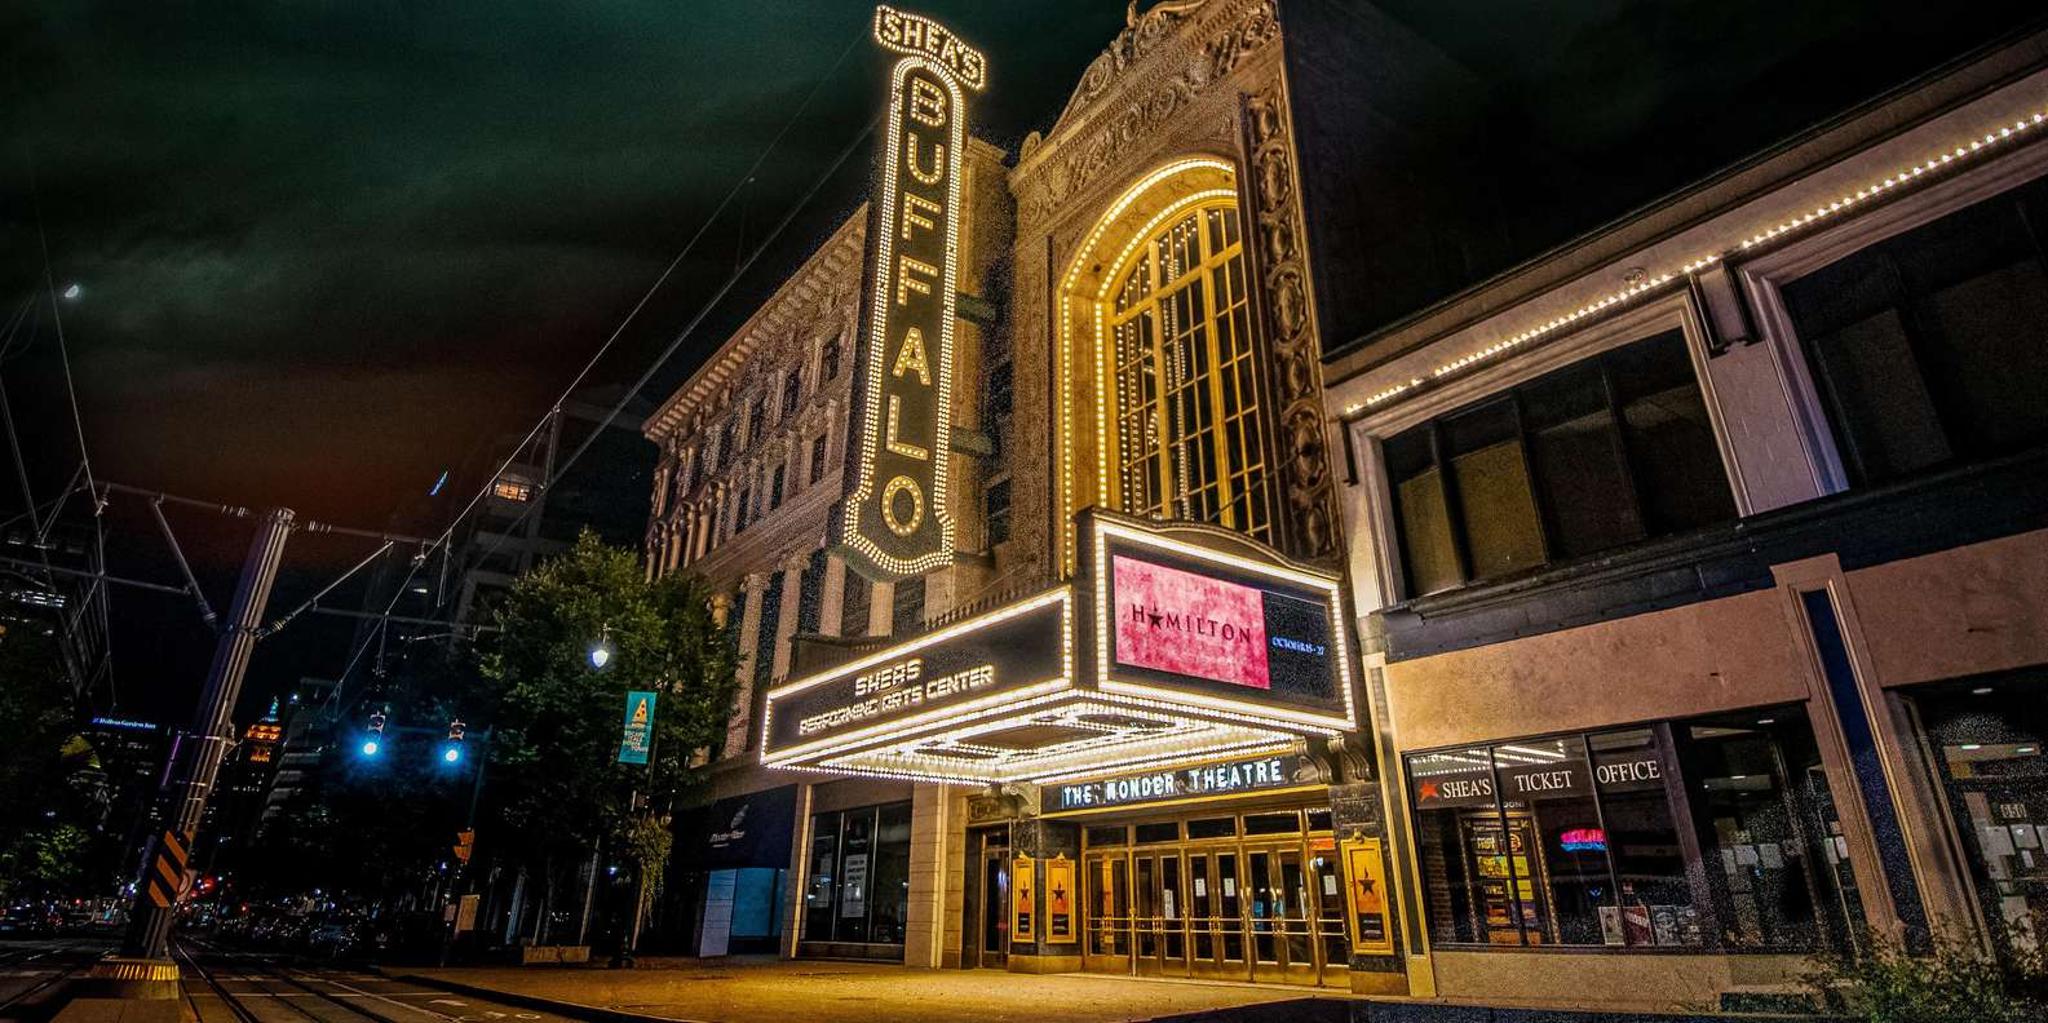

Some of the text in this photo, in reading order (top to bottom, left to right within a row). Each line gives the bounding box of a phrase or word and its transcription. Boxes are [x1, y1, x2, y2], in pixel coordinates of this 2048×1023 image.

[881, 12, 979, 82] SHEA'S
[882, 77, 946, 537] BUFFALO
[799, 664, 994, 735] PERFORMING ARTS CENTER
[1064, 759, 1283, 805] THE WONDER THEATRE
[1442, 760, 1661, 799] SHEA'S TICKET OFFICE
